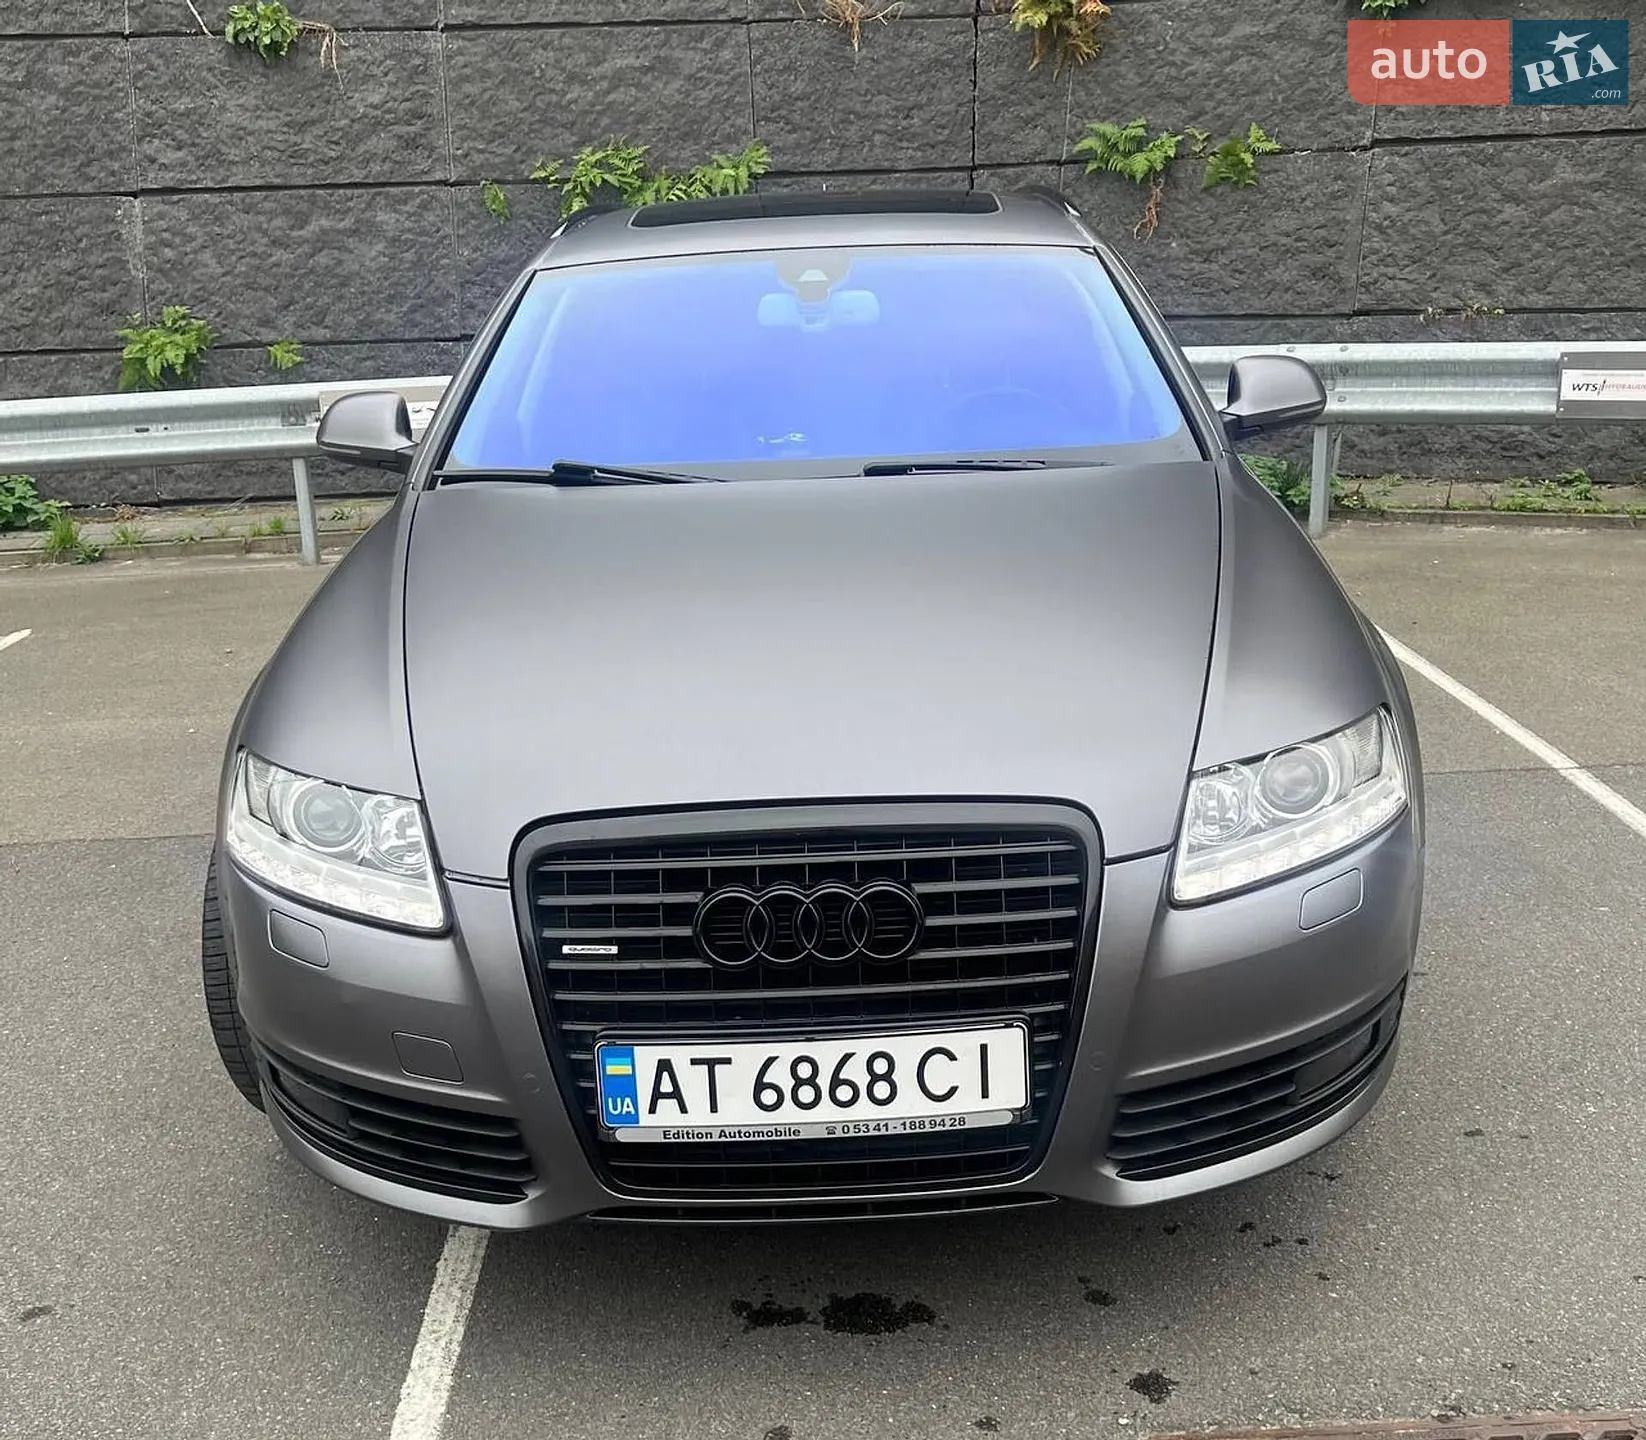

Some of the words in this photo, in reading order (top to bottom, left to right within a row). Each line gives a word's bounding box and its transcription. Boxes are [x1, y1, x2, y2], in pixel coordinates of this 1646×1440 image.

[1572, 382, 1599, 392] WTS
[647, 1056, 733, 1115] AT
[752, 1050, 898, 1113] 6868
[916, 1043, 990, 1103] CI
[608, 1097, 636, 1115] UA
[662, 1129, 713, 1140] Edition
[718, 1126, 801, 1139] Automobile
